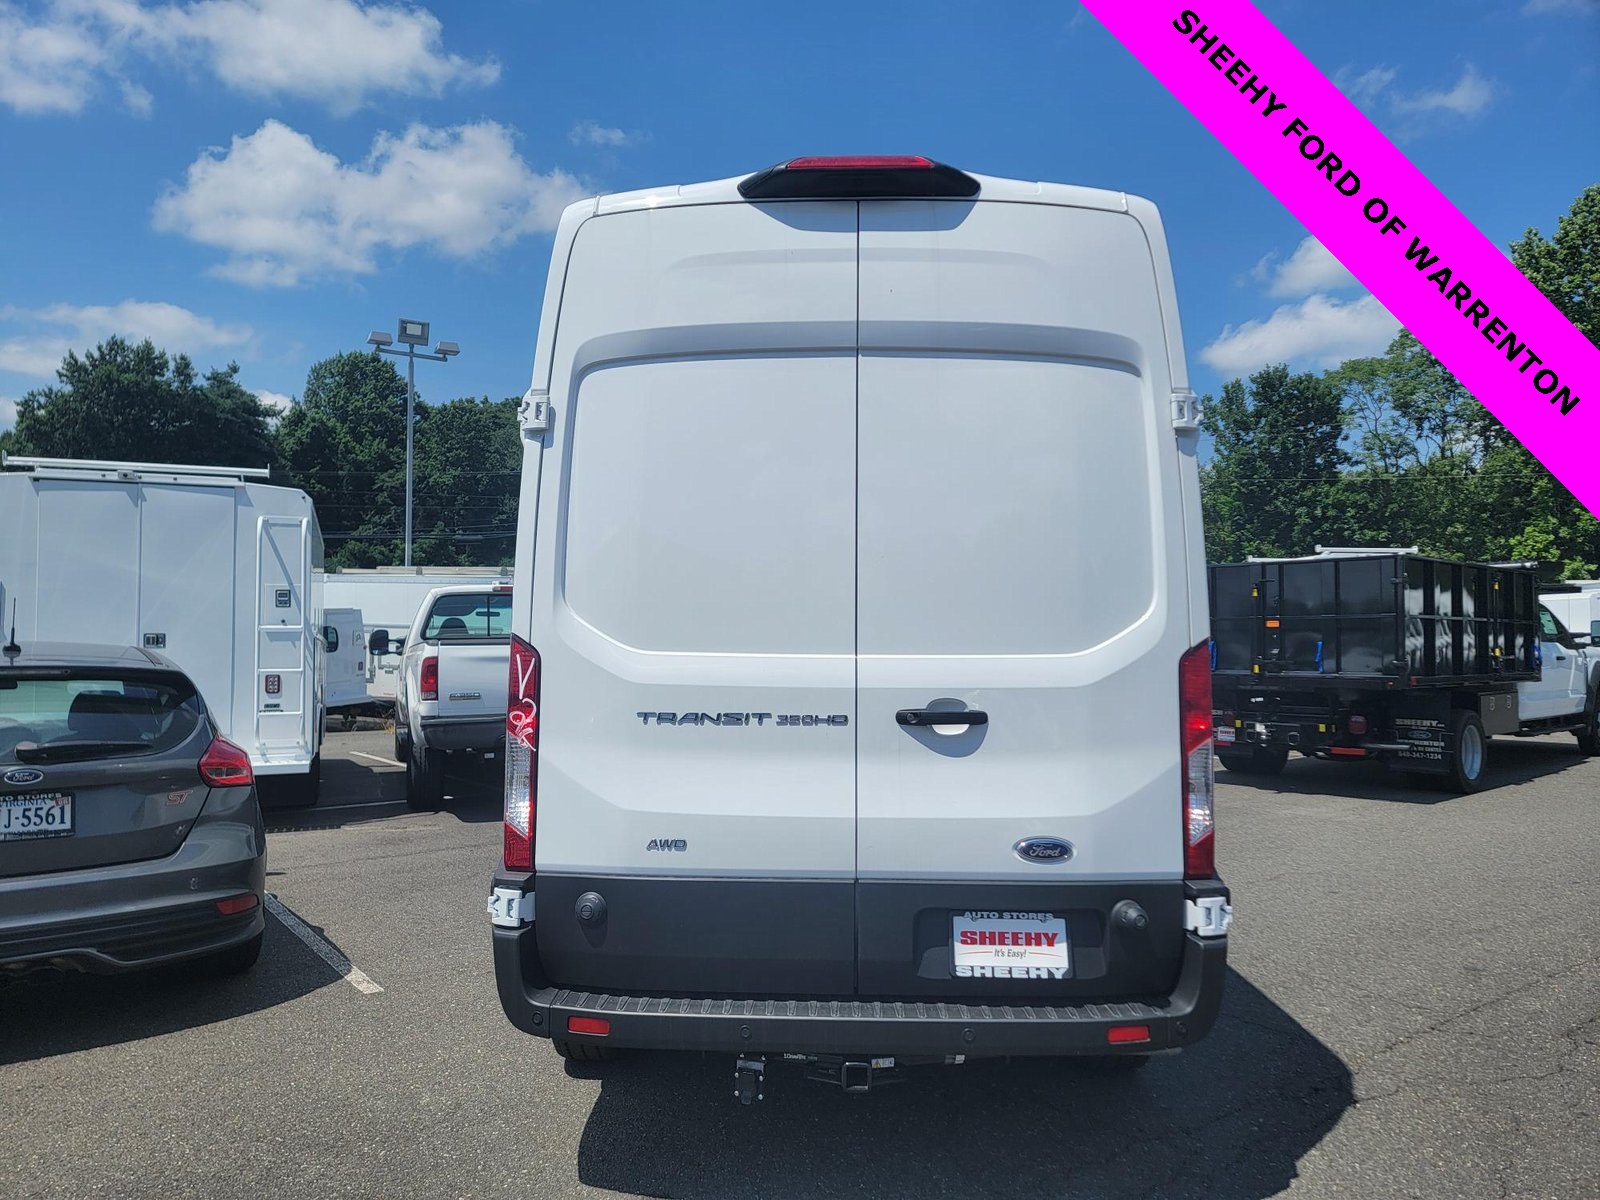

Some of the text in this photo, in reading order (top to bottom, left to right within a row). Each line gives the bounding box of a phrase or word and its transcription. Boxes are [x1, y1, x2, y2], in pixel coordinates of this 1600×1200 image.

[636, 711, 849, 727] TRANSIT 350HD
[0, 805, 66, 829] J-5561
[646, 838, 688, 852] AWD
[1029, 844, 1062, 857] Ford
[963, 911, 1054, 920] AUTO STORES
[960, 930, 1059, 947] SHEEHY
[994, 948, 1027, 960] It's Easy!
[955, 965, 1068, 980] SHEEHY
